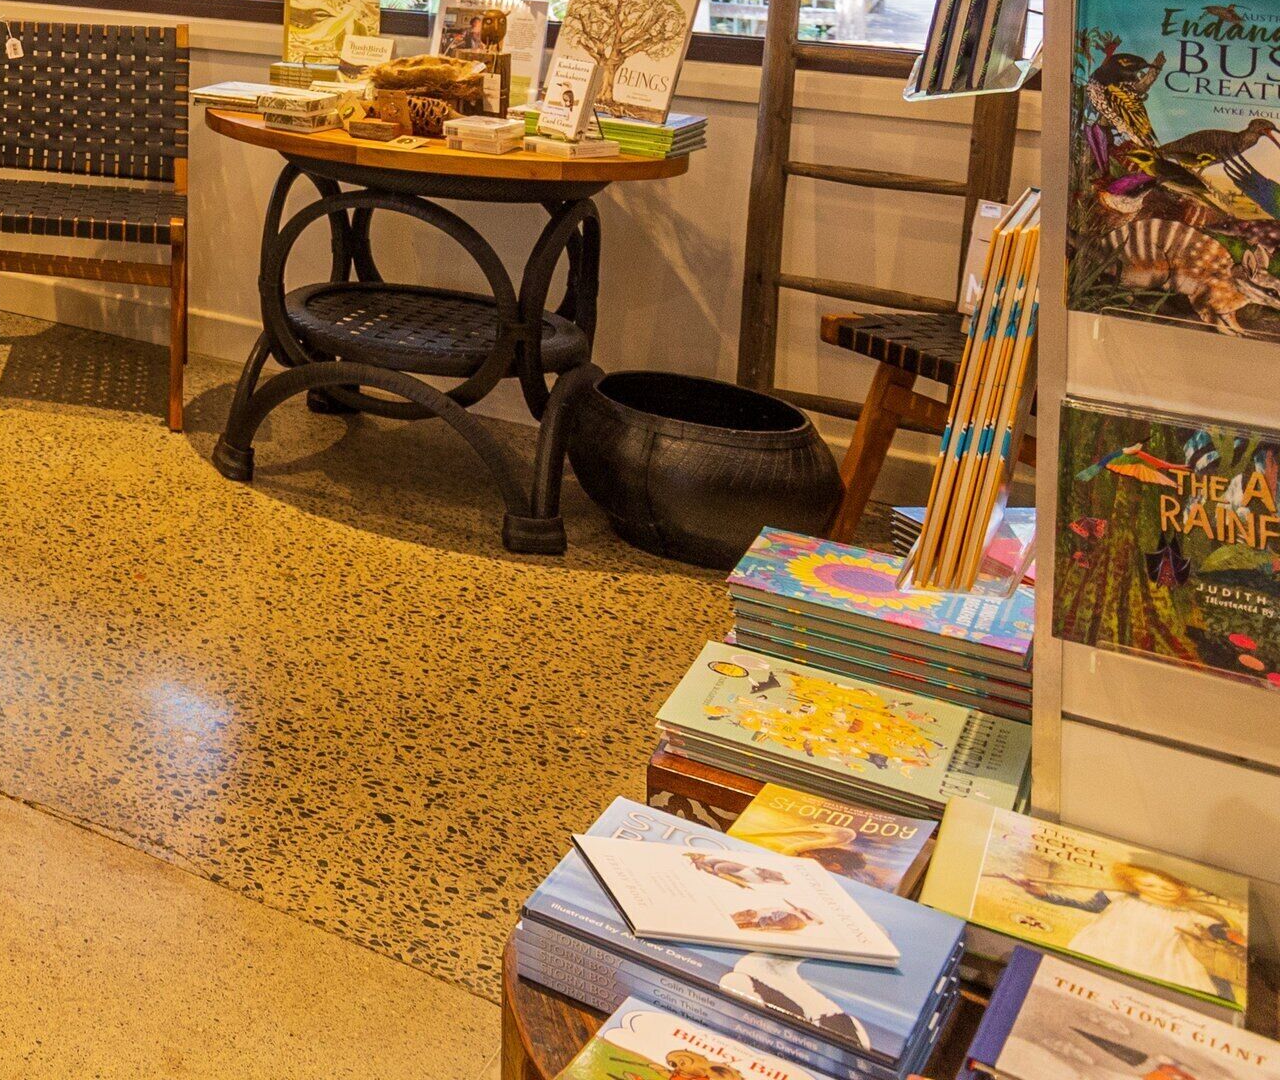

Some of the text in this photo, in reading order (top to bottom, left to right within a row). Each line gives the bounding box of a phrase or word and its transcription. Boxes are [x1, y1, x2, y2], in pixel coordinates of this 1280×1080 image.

[617, 67, 670, 93] BEINGS
[1213, 106, 1244, 117] MYKE
[1169, 469, 1230, 504] THE
[1196, 583, 1269, 606] JUDITH
[859, 815, 919, 840] boy
[546, 928, 624, 969] STORM BOY
[550, 902, 603, 929] Illustrated
[604, 924, 620, 935] by
[665, 947, 704, 969] Davies
[539, 936, 617, 981] STORM BOY
[539, 950, 618, 992] STORM BOY
[540, 963, 618, 1005] STORM BOY
[542, 977, 588, 1002] STORM
[659, 977, 716, 1007] Colin Thiele
[652, 989, 709, 1018] Colin Thiele
[652, 1000, 677, 1016] Colin
[1054, 976, 1101, 1001] THE
[1108, 998, 1183, 1036] STONE
[1191, 1030, 1269, 1066] GIANT
[733, 1024, 810, 1062] Andrew Davies
[741, 1012, 819, 1051] Andrew Davies
[672, 1028, 789, 1080] Blinky Bill
